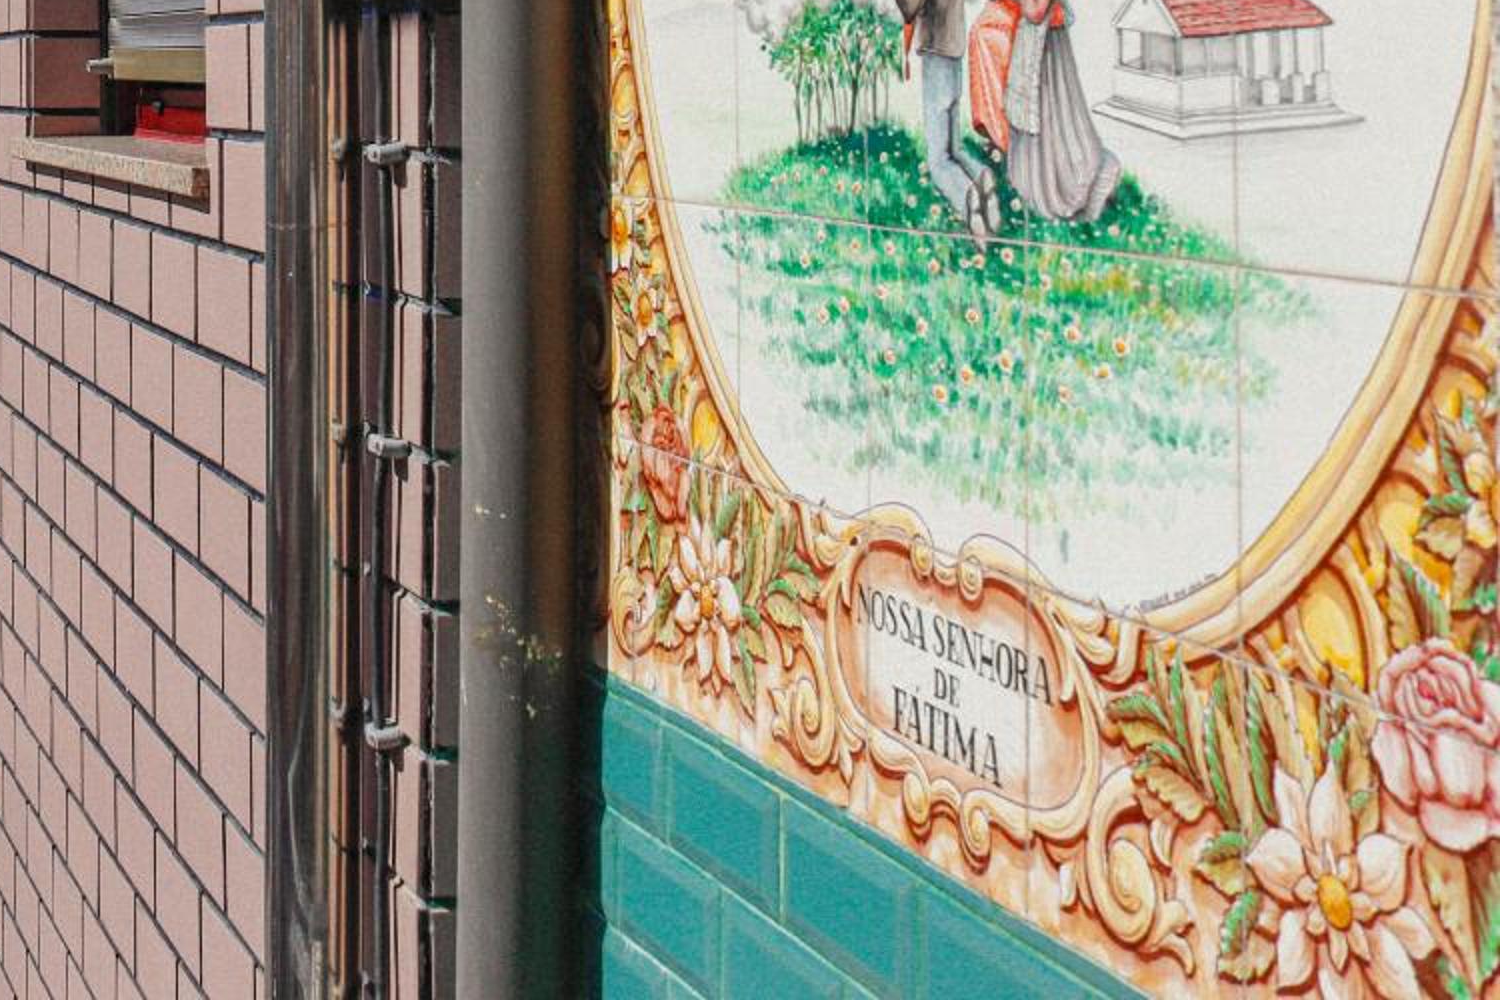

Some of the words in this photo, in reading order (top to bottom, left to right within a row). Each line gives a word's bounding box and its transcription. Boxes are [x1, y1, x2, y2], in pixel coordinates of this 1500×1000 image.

[857, 583, 927, 653] NOSSA
[932, 615, 1054, 707] SENHORA
[933, 667, 961, 709] DE
